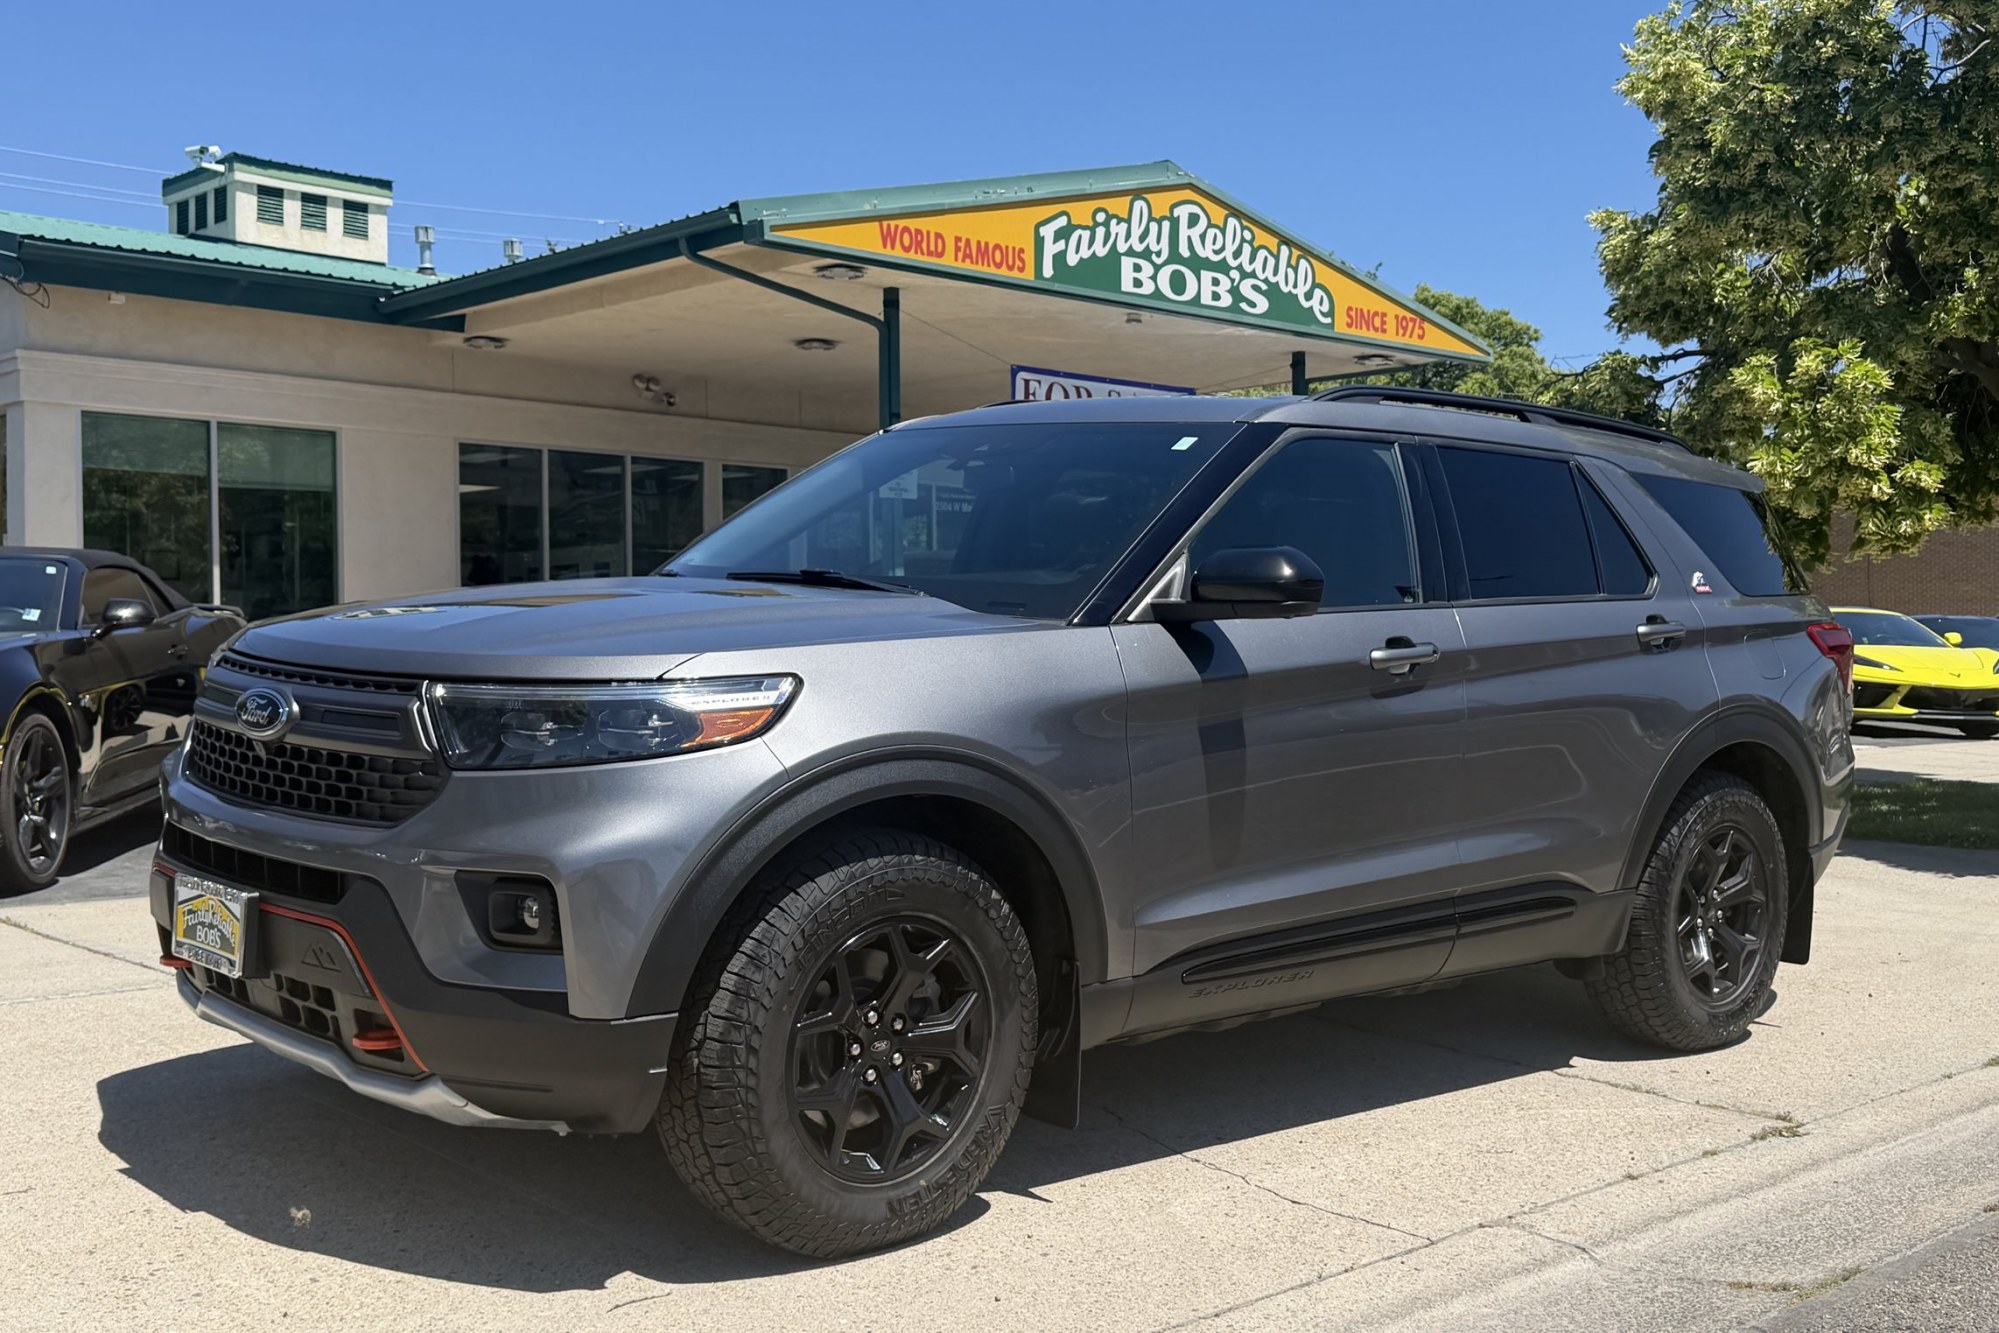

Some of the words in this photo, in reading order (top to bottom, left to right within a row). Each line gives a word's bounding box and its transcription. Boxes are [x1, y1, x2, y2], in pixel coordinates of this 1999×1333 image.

[878, 221, 946, 259] WORLD
[953, 236, 1026, 274] FAMOUS
[1039, 200, 1171, 279] Fairly
[1173, 203, 1332, 324] Reliable
[1120, 255, 1269, 315] BOB'S
[1345, 306, 1388, 334] SINCE
[1394, 314, 1426, 341] 1975
[241, 697, 272, 725] Ford
[183, 903, 209, 929] Fairly
[208, 899, 236, 947] Reliable
[196, 925, 221, 949] BOB'S
[1187, 970, 1316, 999] EXPLORER
